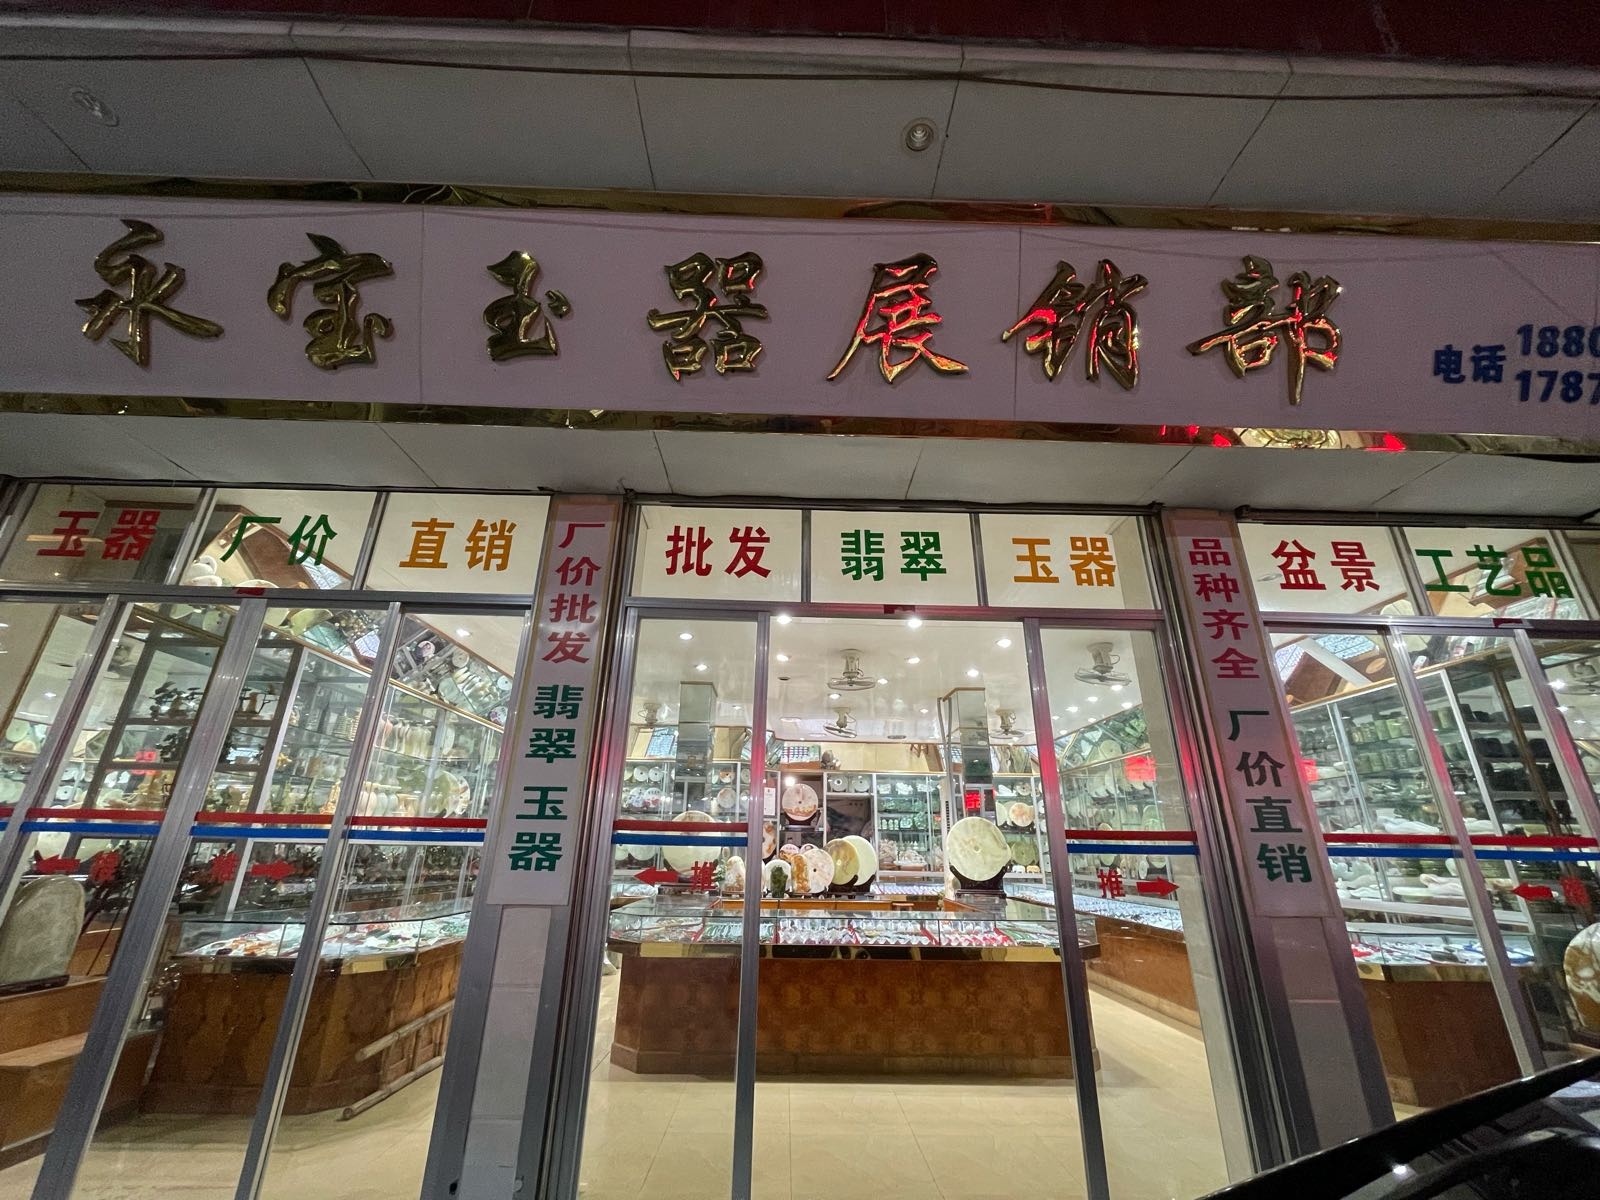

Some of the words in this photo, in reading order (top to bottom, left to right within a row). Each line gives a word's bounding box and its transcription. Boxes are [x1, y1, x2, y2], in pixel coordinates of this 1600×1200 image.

[1433, 344, 1507, 384] 电话
[37, 507, 161, 561] 玉器
[220, 513, 338, 566] 厂价
[399, 518, 517, 572] 直销
[665, 526, 771, 579] 批发
[840, 529, 947, 582] 翡翠
[1012, 536, 1117, 588] 玉器
[1271, 539, 1381, 593] 盆景
[1415, 544, 1573, 600] 工艺品
[541, 522, 604, 665] 厂价批发
[525, 684, 583, 765] 翡翠
[1188, 537, 1261, 680] 品种齐全
[1227, 709, 1313, 884] 厂价直销
[508, 785, 568, 873] 玉器
[1096, 867, 1126, 899] 推
